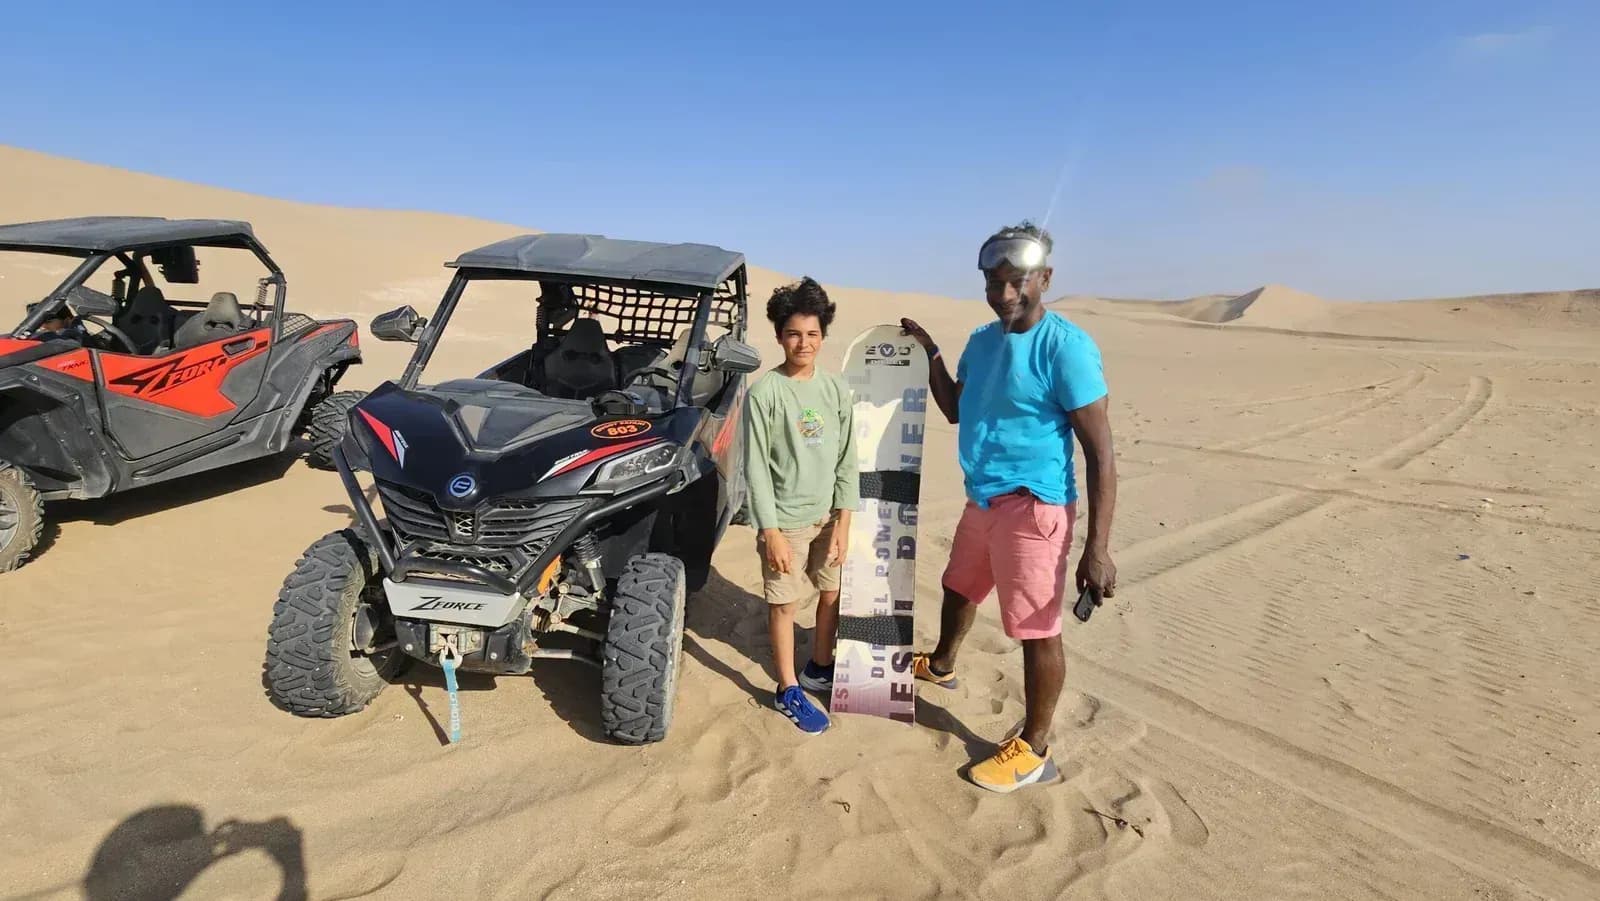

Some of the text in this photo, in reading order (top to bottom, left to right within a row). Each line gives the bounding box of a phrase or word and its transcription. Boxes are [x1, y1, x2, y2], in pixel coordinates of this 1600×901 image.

[607, 425, 638, 436] 803
[871, 508, 892, 679] DIEEL POWE
[408, 596, 487, 611] ZFORCE
